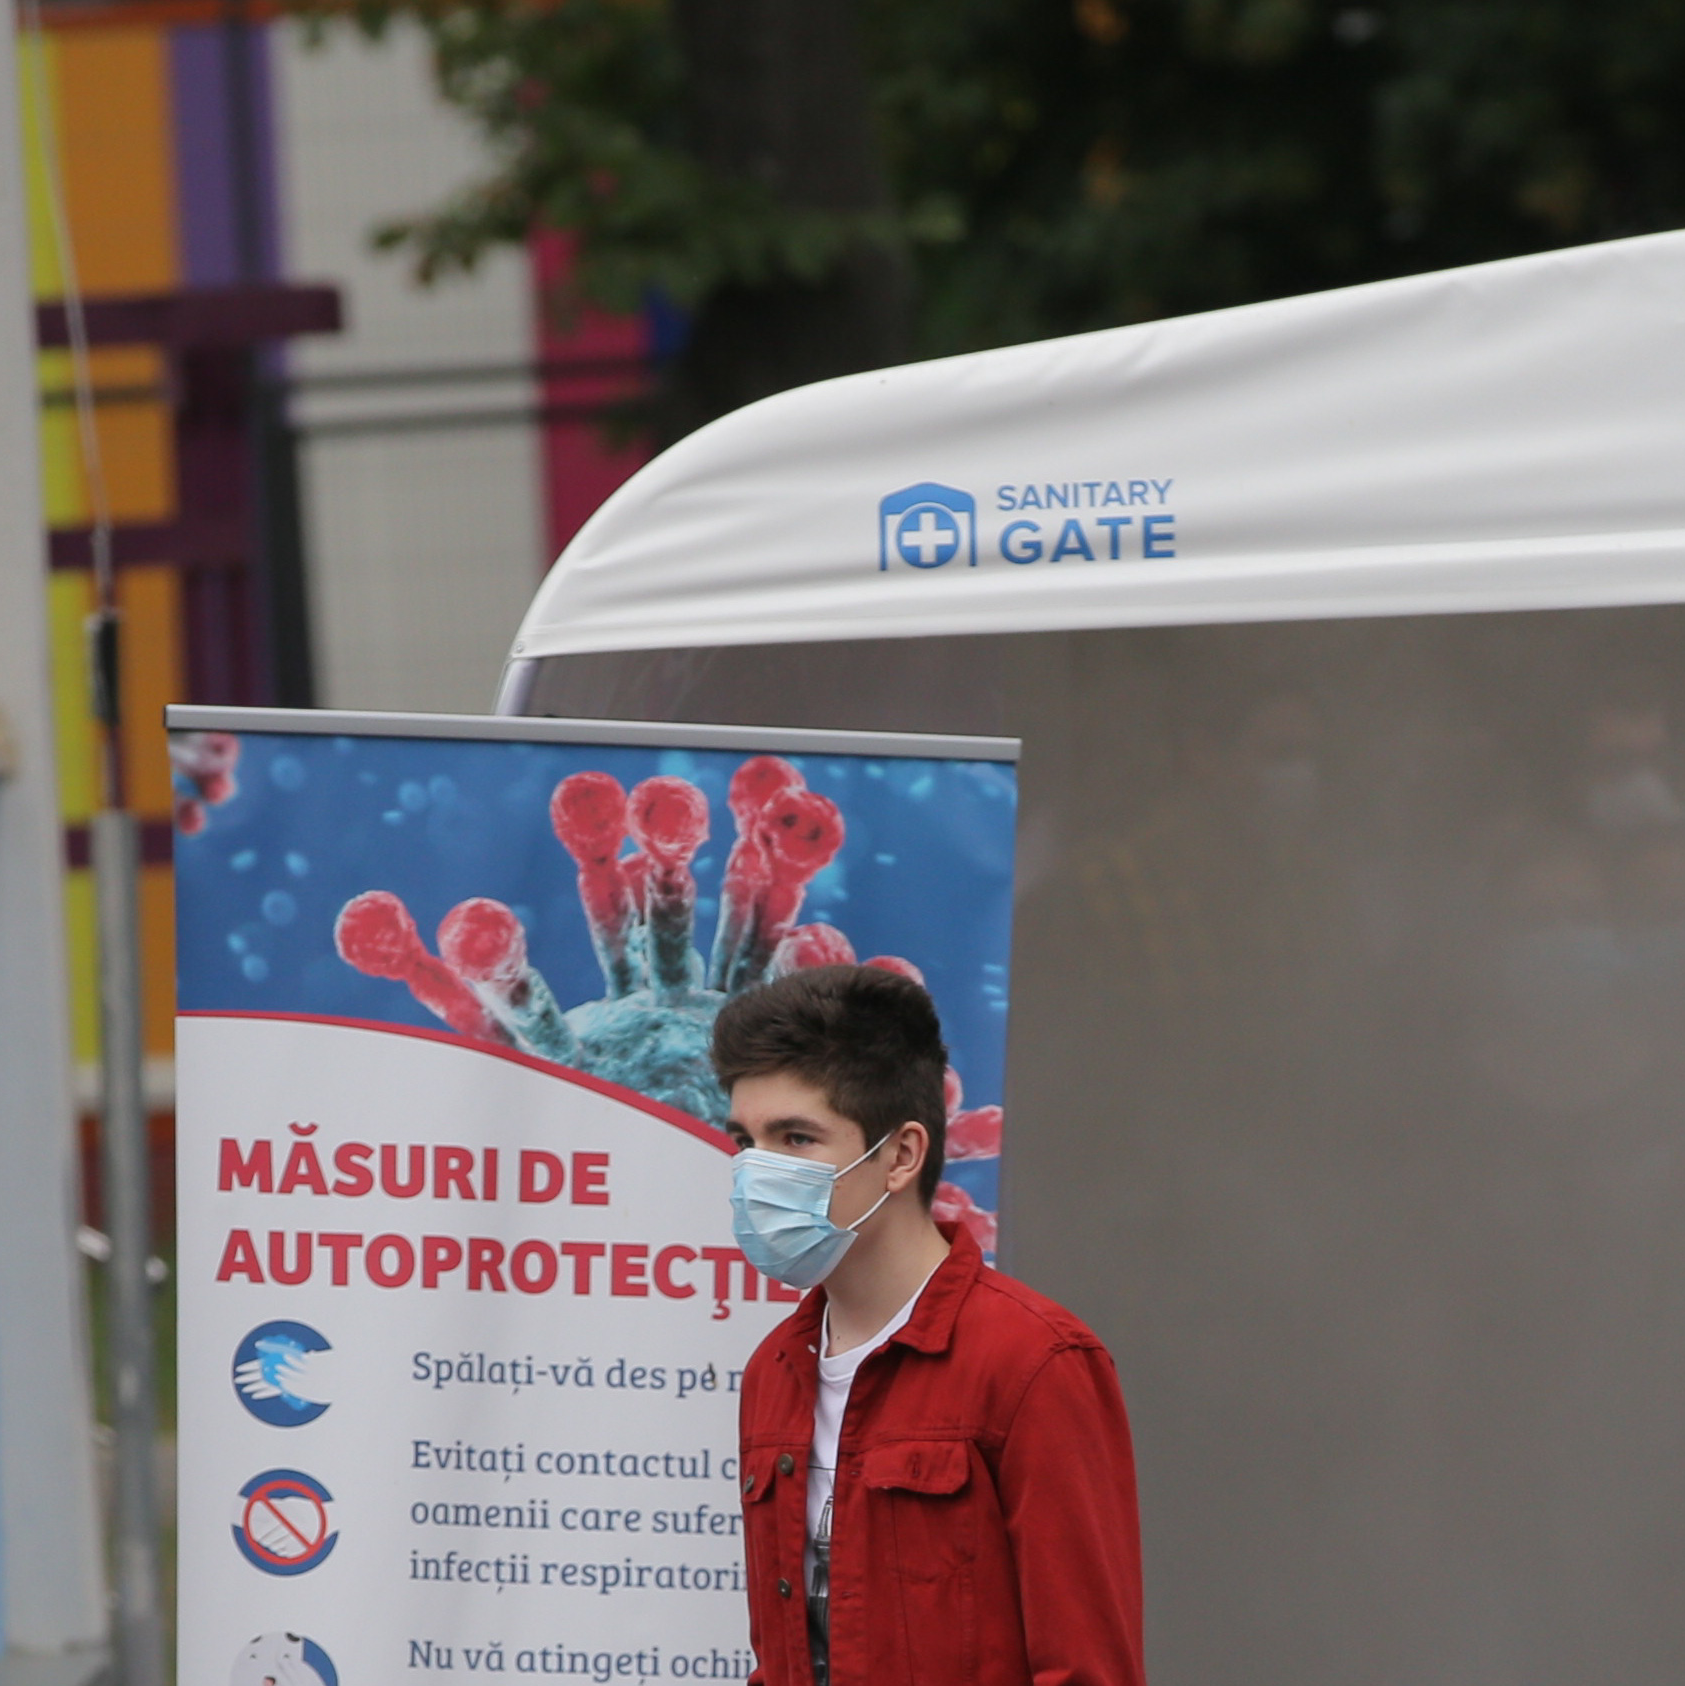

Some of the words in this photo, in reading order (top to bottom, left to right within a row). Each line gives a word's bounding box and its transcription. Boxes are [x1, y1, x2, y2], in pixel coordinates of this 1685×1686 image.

[997, 479, 1173, 511] SANITARY
[999, 514, 1176, 565] GATE
[219, 1123, 499, 1202] MĂSURI
[519, 1149, 610, 1206] DE
[412, 1351, 595, 1395] Spălați-vă
[604, 1357, 667, 1391] des
[676, 1368, 718, 1399] pe
[411, 1439, 526, 1481] Evitați
[535, 1448, 712, 1480] contactul
[720, 1457, 738, 1481] c
[409, 1498, 551, 1530] oamenii
[559, 1507, 643, 1533] care
[651, 1503, 741, 1537] sufer
[409, 1549, 531, 1593] infecții
[409, 1639, 454, 1671] Nu
[461, 1641, 506, 1672] vă
[515, 1643, 661, 1686] atingeți
[670, 1647, 751, 1680] ochii
